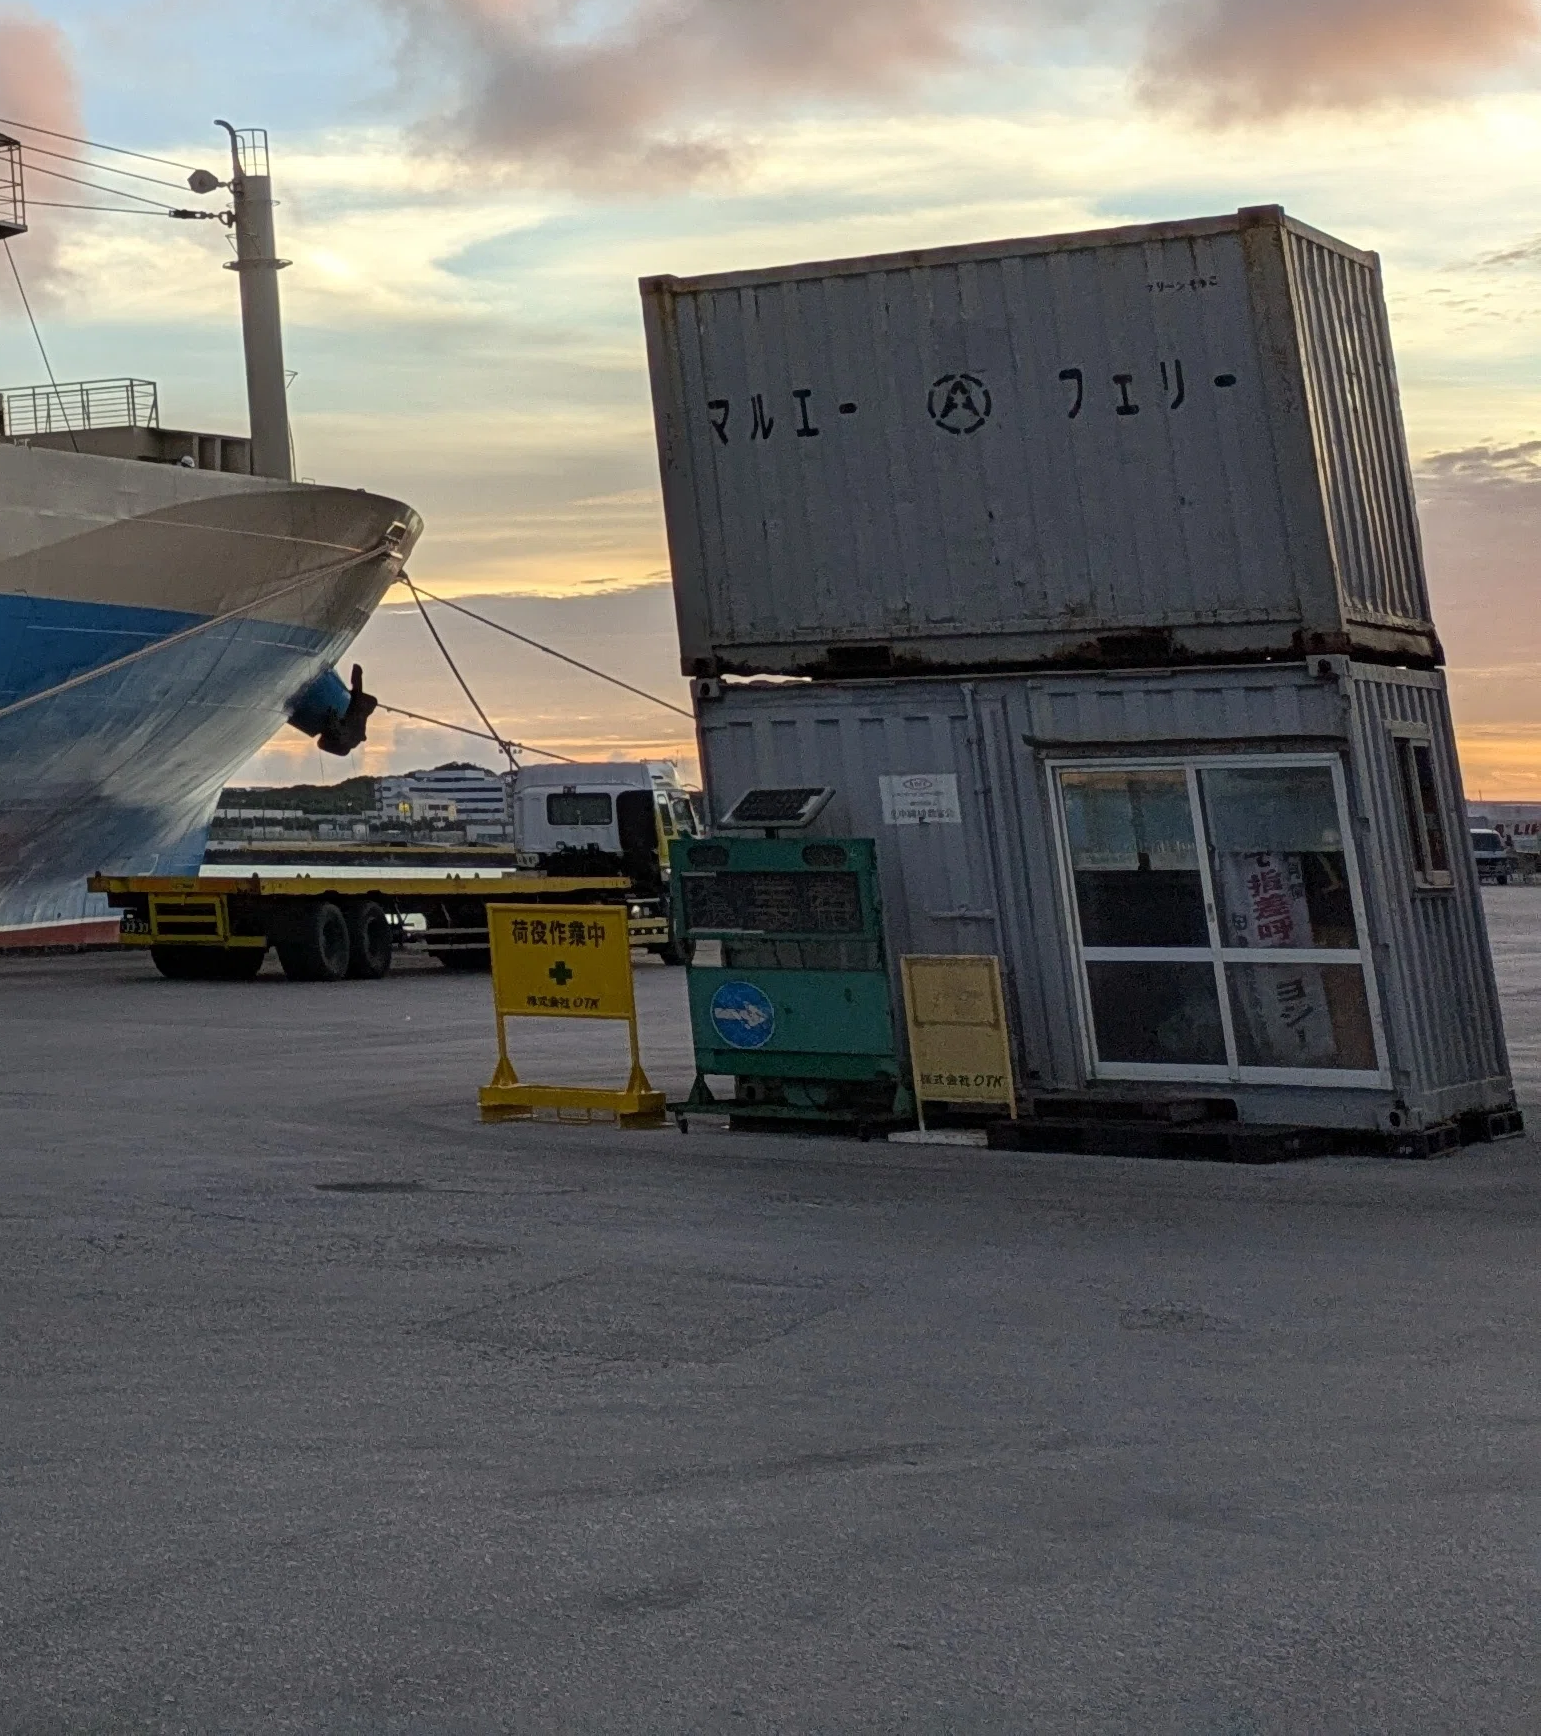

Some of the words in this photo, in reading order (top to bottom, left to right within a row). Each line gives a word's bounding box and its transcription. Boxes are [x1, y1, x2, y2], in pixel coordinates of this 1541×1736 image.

[707, 387, 858, 446] マルエー
[1058, 358, 1238, 420] フェリー
[511, 919, 606, 948] 荷役作業中
